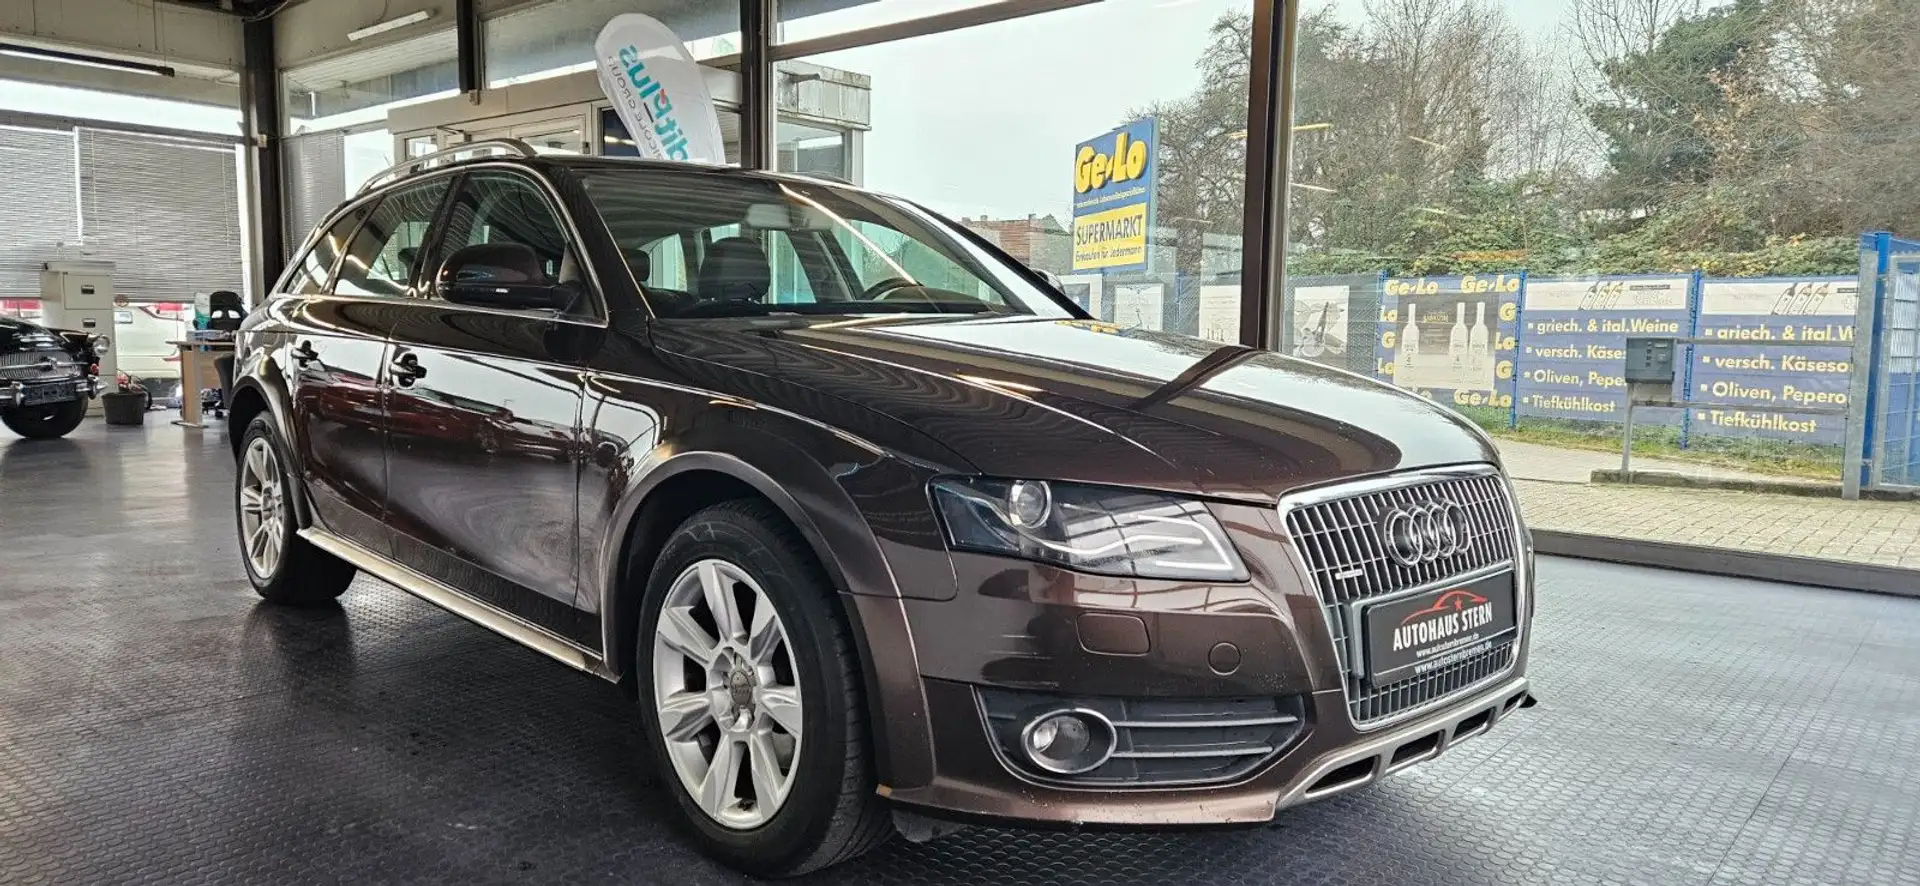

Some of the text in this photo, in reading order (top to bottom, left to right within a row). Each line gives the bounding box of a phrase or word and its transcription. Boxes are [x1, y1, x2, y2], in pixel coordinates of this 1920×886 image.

[1076, 214, 1143, 246] SUPERMARKT
[1537, 318, 1583, 335] griech.
[1587, 318, 1598, 332] &
[1782, 324, 1796, 340] &
[1535, 343, 1582, 359] versch.
[1714, 353, 1776, 370] versch.
[1534, 369, 1627, 389] Oliven, Pepe
[1712, 381, 1777, 402] Oliven,
[1532, 392, 1616, 412] Tiefkühlkost
[1710, 410, 1816, 433] Tiefkühlkost
[1393, 601, 1493, 651] AUTOHAUS STERN
